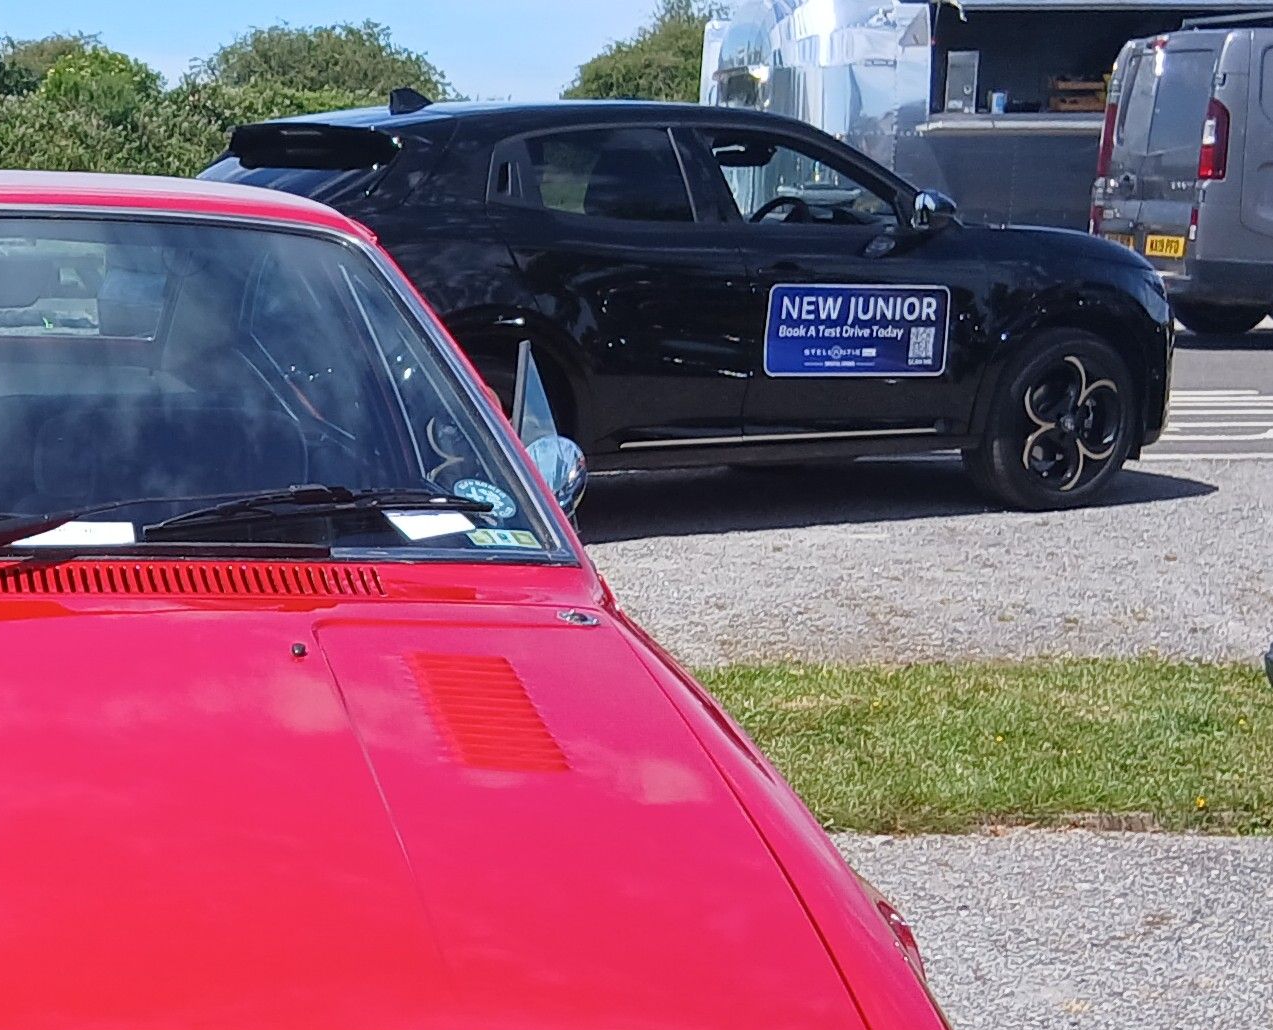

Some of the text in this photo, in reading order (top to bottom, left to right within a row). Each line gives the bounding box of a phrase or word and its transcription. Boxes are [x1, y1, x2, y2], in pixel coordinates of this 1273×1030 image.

[780, 296, 937, 325] NEW JUNIOR
[778, 325, 904, 340] Book A Test Drive Today
